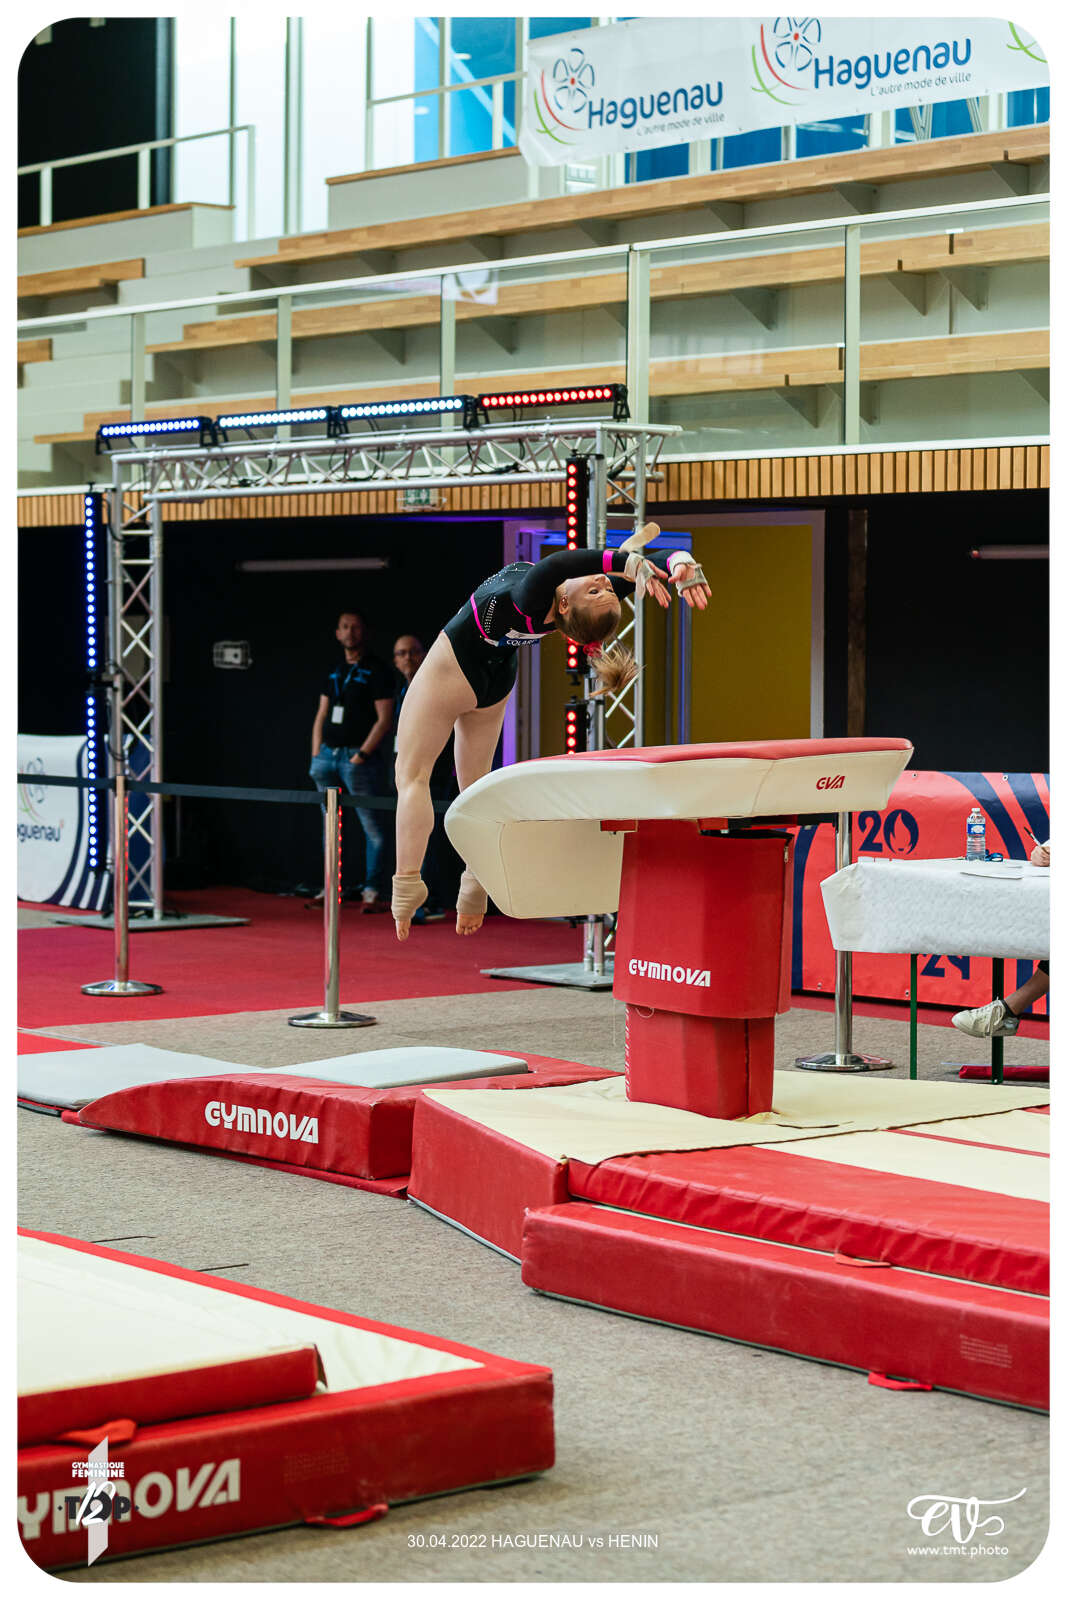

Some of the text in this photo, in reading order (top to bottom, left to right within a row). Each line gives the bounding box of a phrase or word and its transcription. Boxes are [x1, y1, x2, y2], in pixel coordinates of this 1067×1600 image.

[813, 38, 972, 90] Haguenau
[870, 72, 972, 97] L'autre mode de ville
[588, 81, 723, 129] Haguenau
[17, 823, 61, 843] guenau
[628, 958, 712, 988] GYMNOVA
[204, 1100, 319, 1144] GYMNOVA
